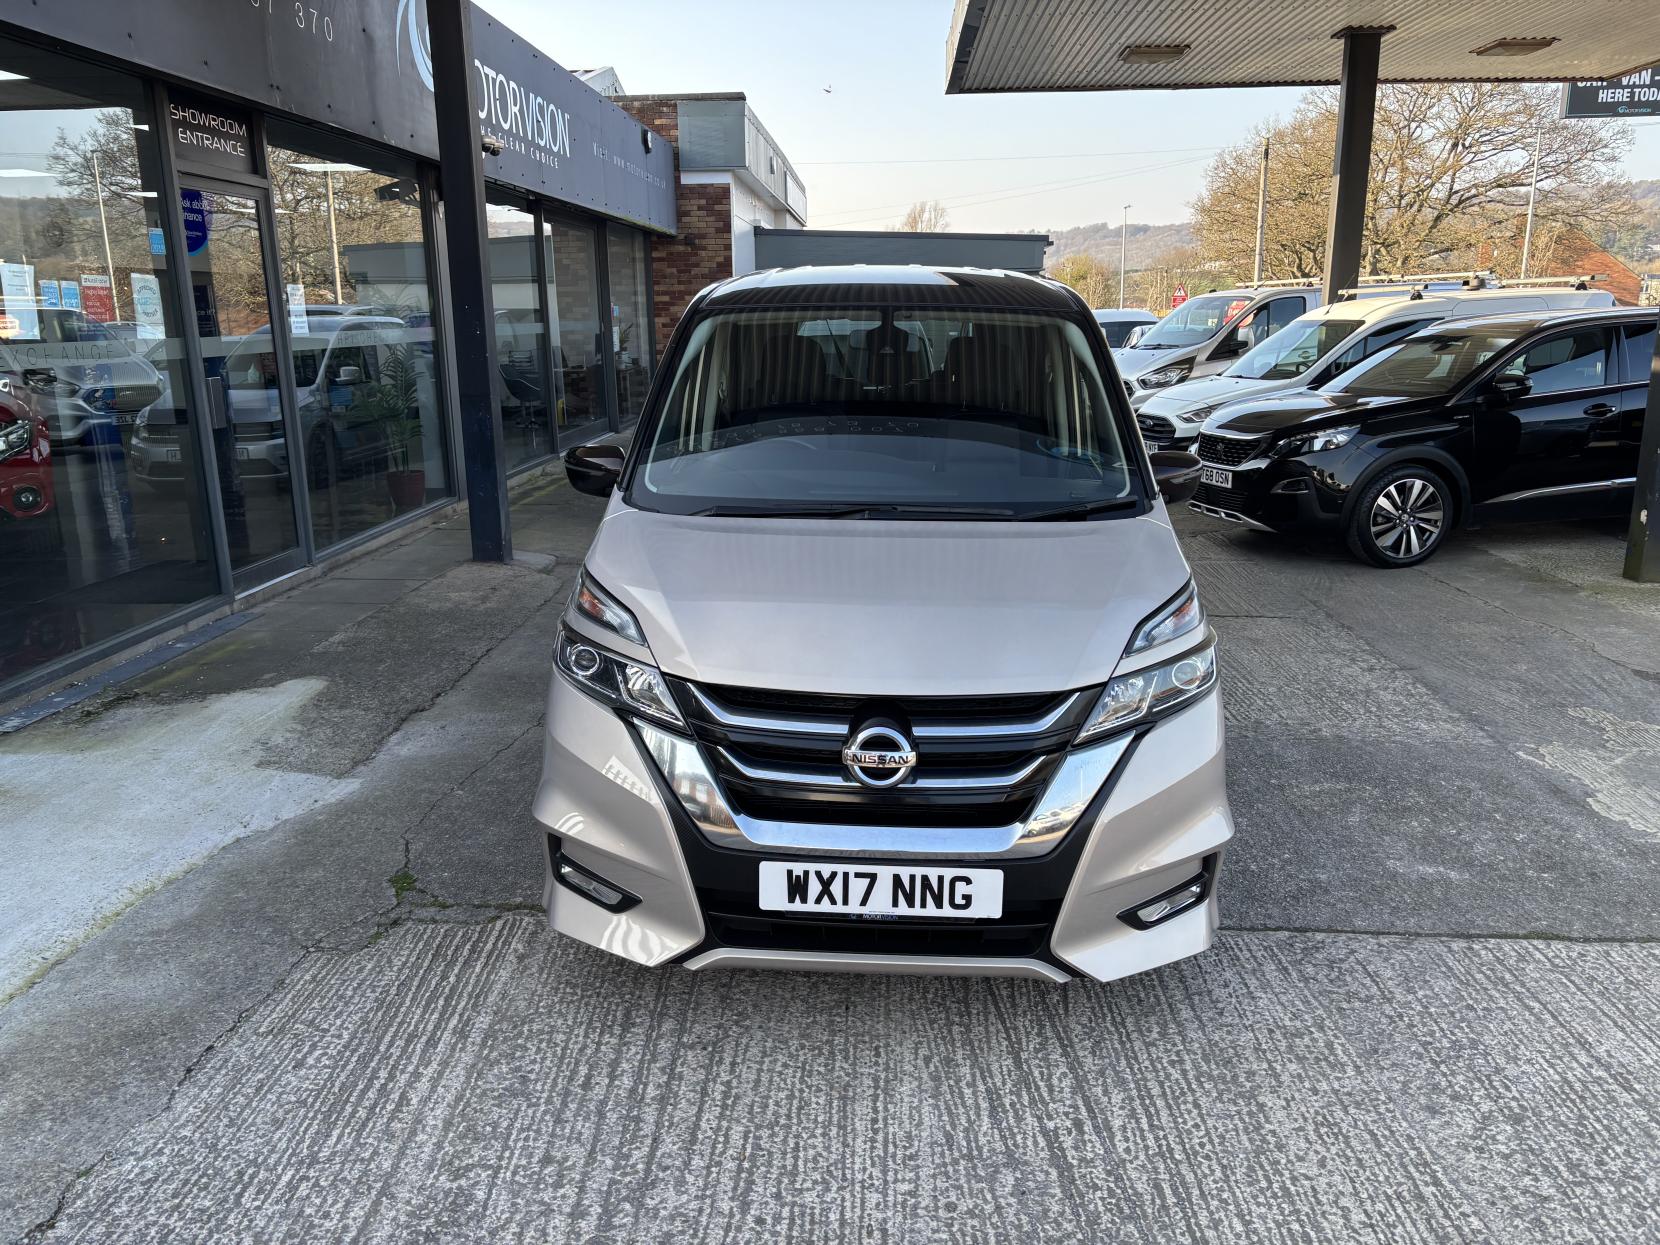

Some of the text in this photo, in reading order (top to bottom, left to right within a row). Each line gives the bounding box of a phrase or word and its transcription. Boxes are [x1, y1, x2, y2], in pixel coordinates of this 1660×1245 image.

[295, 2, 333, 42] 370
[1597, 88, 1631, 103] HERE
[169, 103, 247, 137] SHOWROOM
[178, 127, 247, 157] ENTRANCE
[530, 147, 559, 169] CHOICE
[1215, 471, 1230, 486] OSN
[851, 753, 909, 765] NISSAN
[786, 868, 974, 910] WX17 NNG
